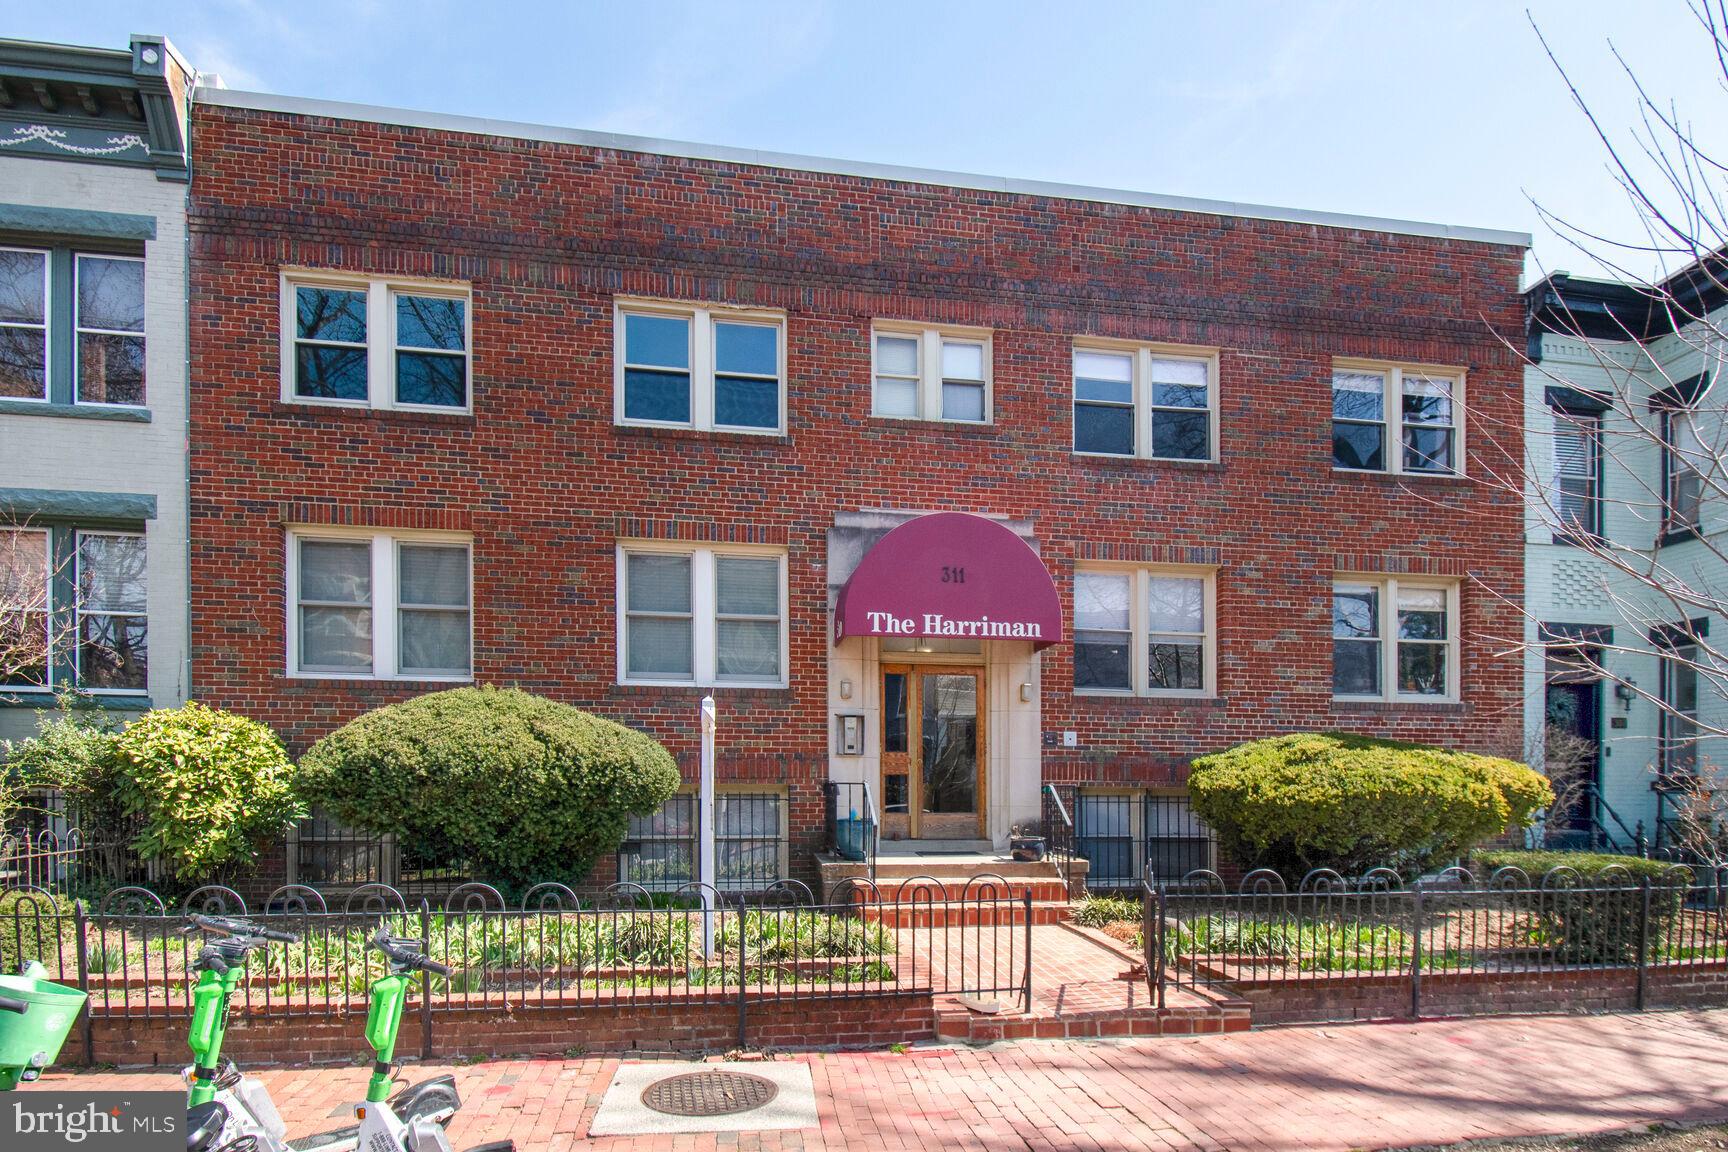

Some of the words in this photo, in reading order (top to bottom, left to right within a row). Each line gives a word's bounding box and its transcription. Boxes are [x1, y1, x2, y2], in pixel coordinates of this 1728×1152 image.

[941, 566, 966, 584] 311
[867, 611, 916, 633] The
[922, 613, 1042, 638] Harriman
